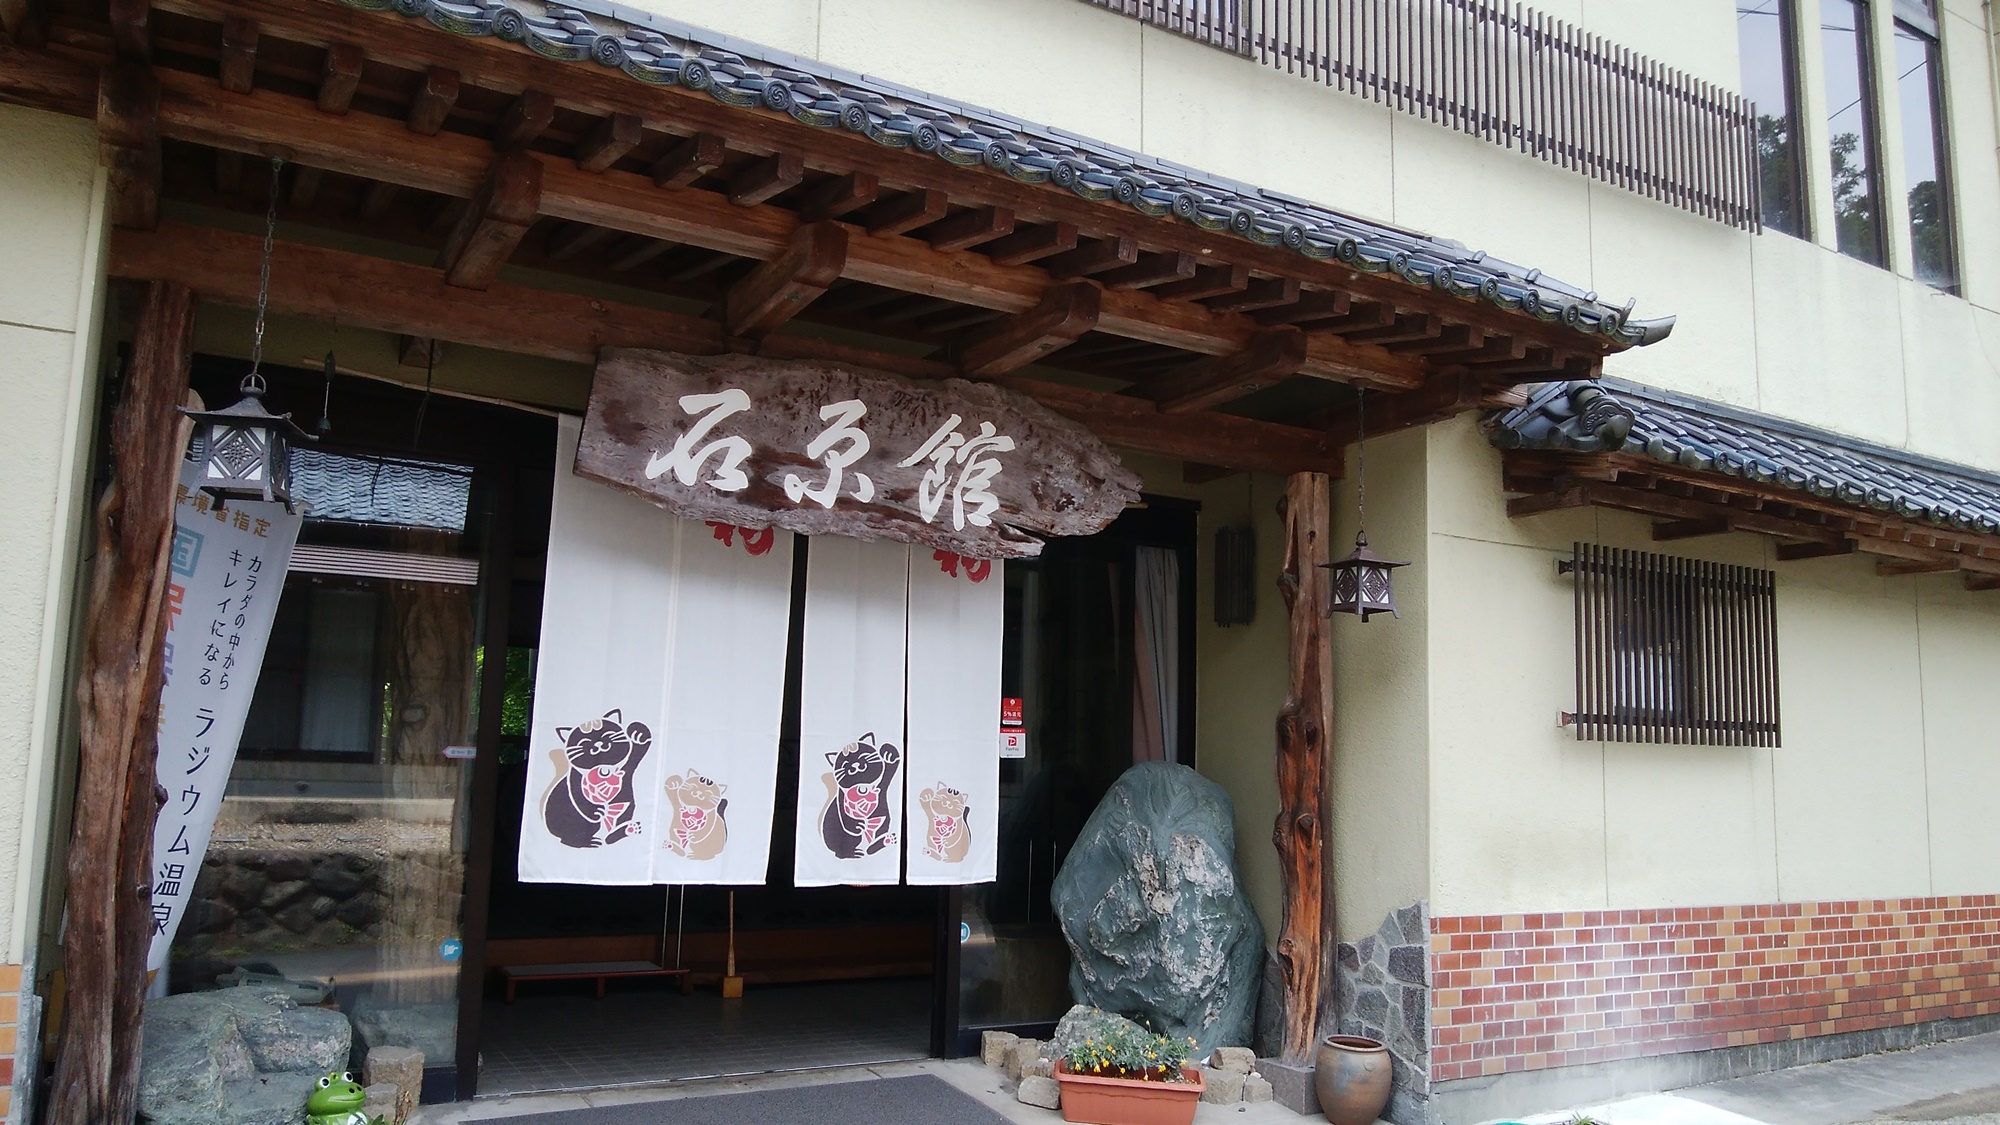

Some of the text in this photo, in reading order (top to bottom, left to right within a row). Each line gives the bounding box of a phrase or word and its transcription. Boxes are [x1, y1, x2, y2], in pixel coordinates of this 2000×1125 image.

[199, 550, 242, 685] キレイになる
[219, 556, 262, 690] カラダの中から
[152, 708, 215, 936] ラジウム温泉
